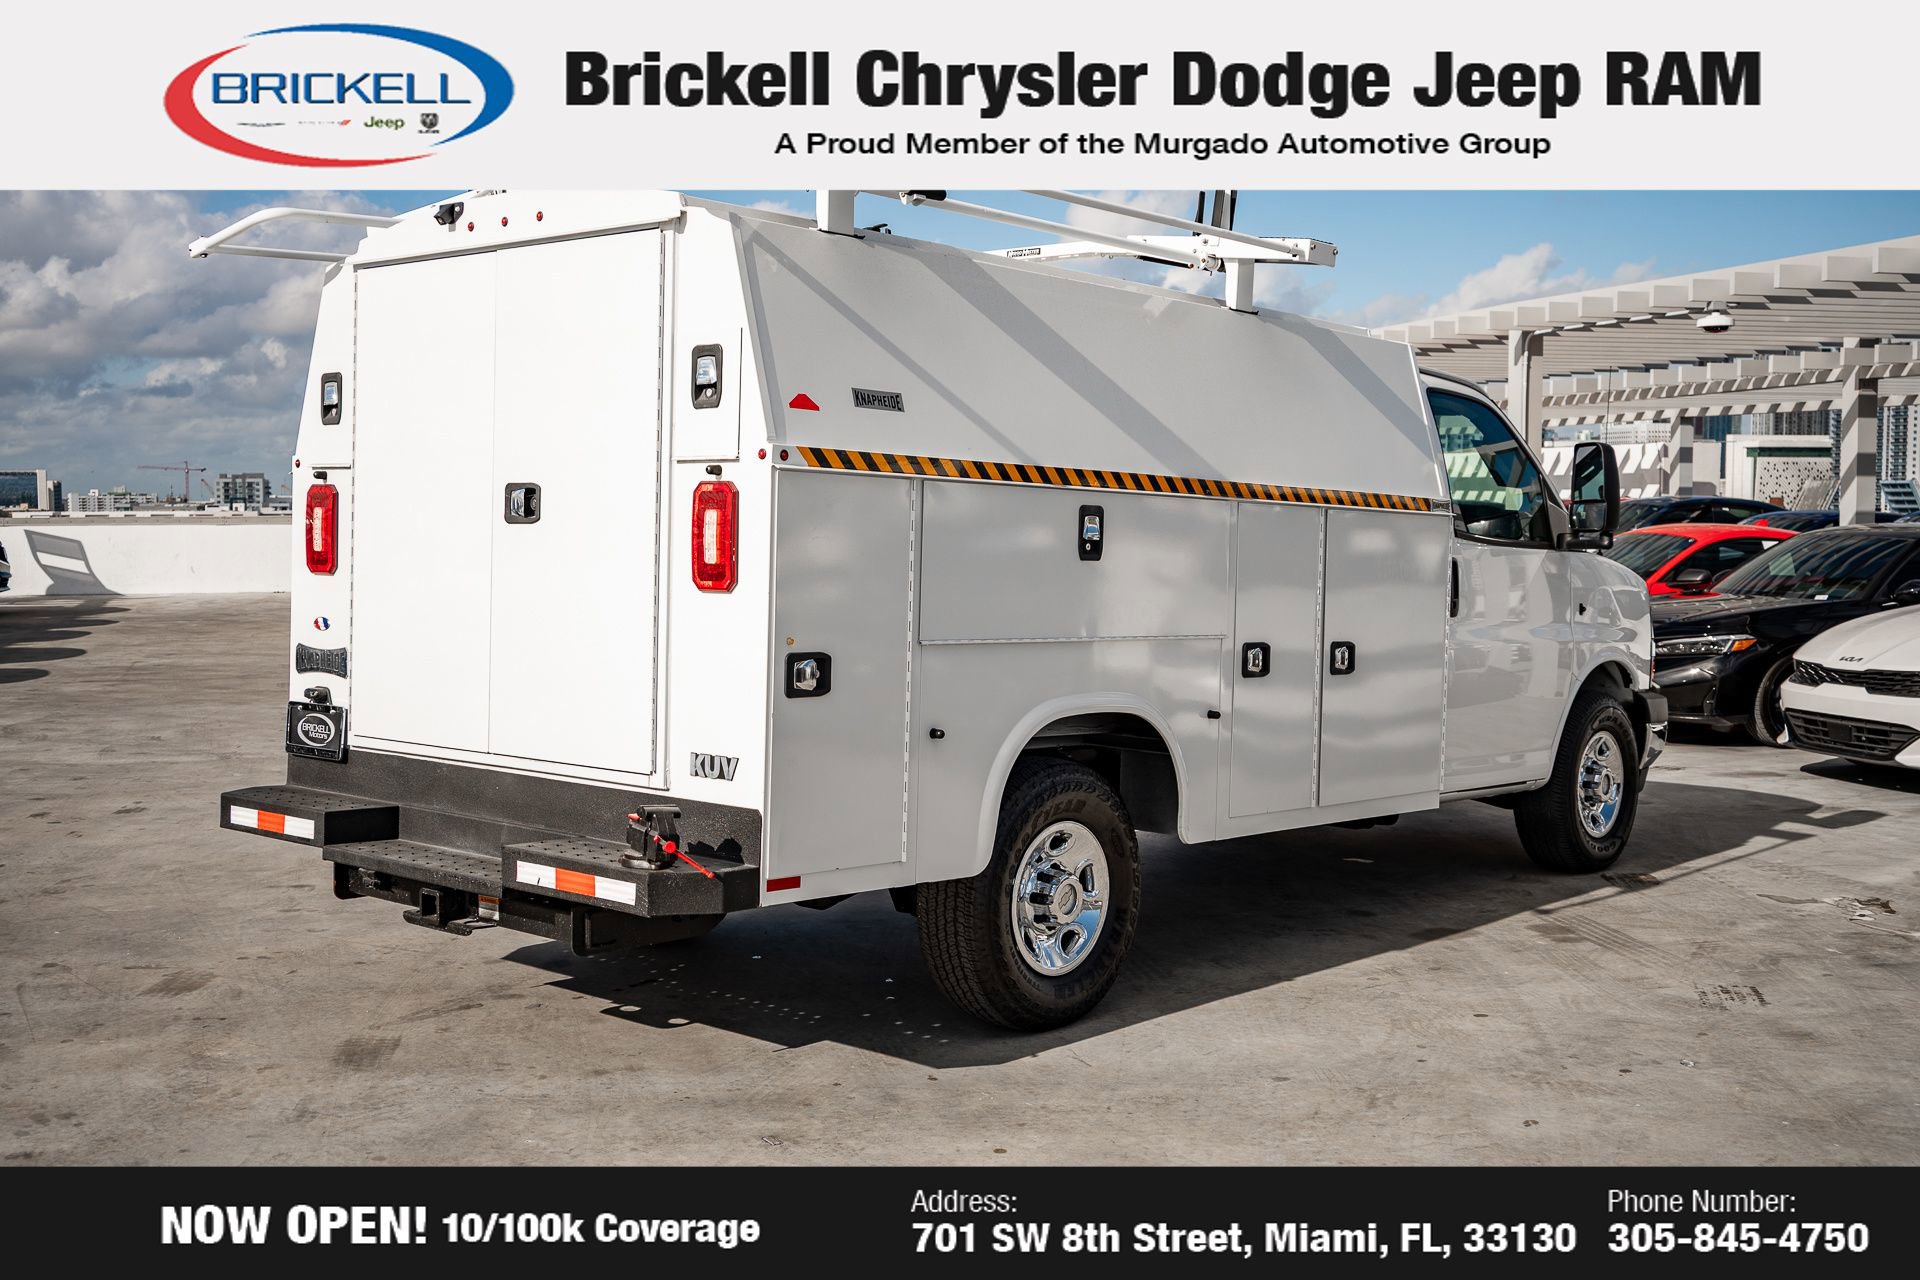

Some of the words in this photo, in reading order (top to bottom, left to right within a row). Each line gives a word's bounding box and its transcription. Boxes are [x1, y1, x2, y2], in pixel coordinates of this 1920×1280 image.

[854, 389, 902, 411] KNAPHEIDE
[302, 722, 331, 735] BRICKELL
[309, 731, 328, 740] Motors
[690, 752, 739, 782] KUV
